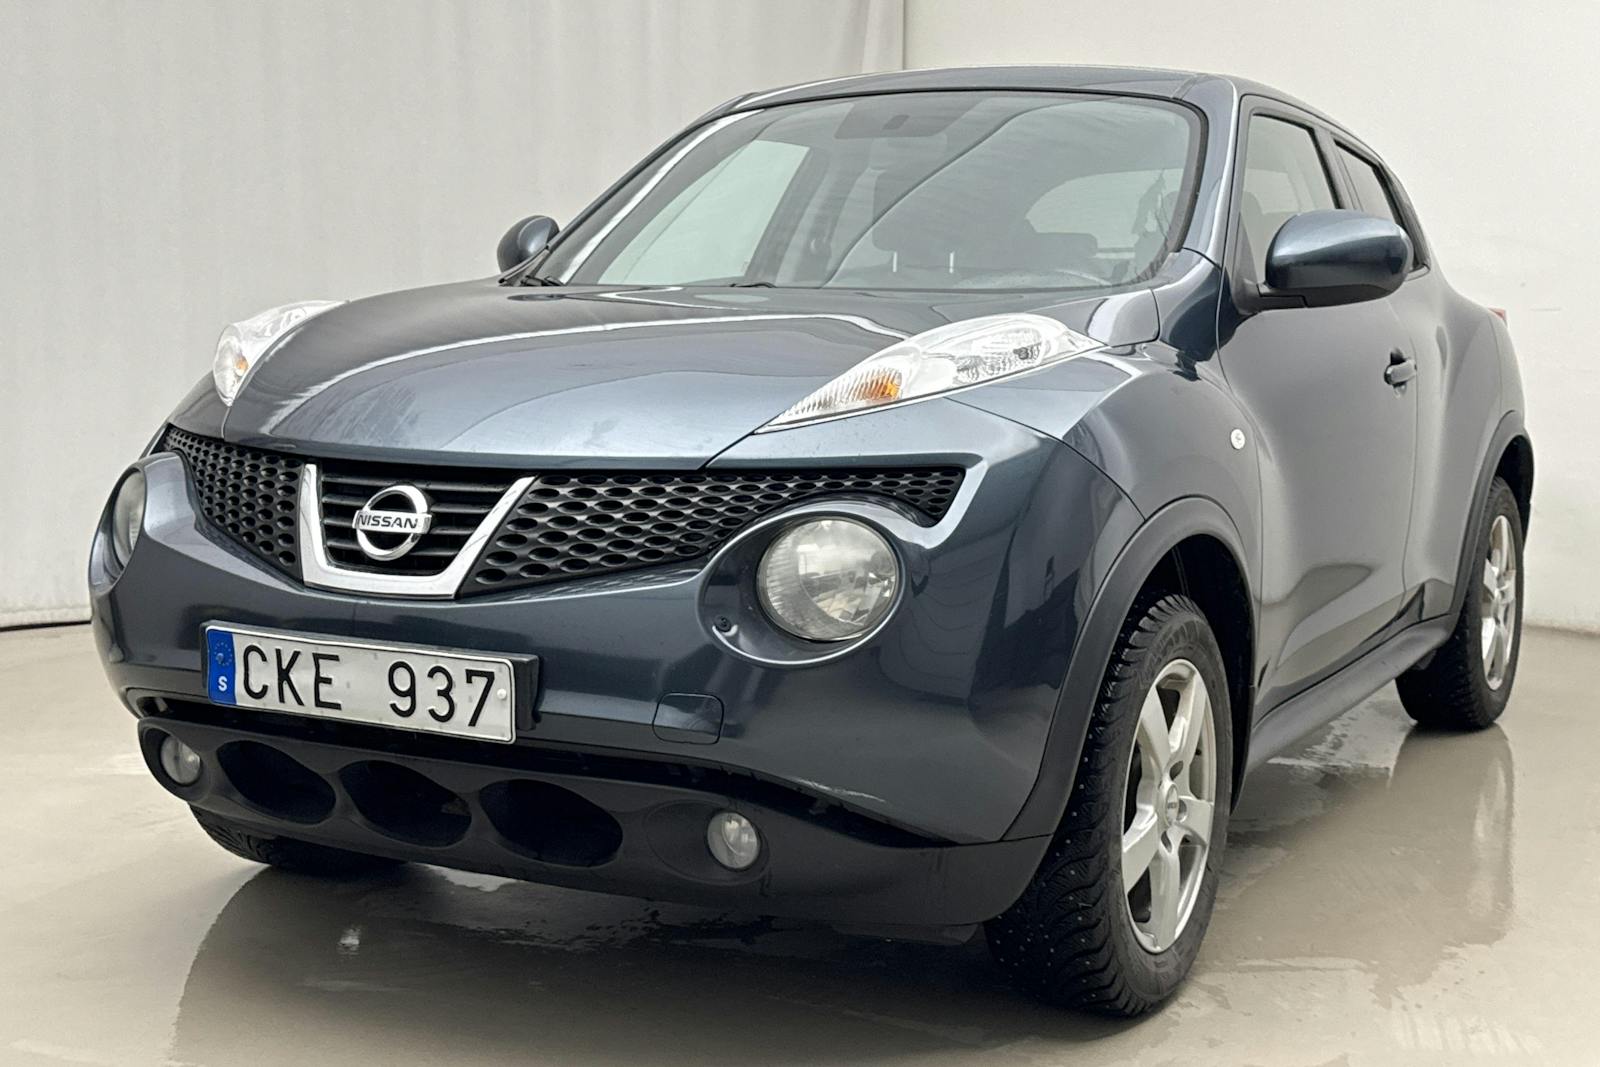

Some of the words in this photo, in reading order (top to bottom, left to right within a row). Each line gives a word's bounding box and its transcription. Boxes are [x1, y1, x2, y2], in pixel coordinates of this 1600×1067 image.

[359, 514, 418, 529] NISSAN
[218, 675, 228, 692] S
[243, 644, 342, 711] CKE
[388, 661, 495, 727] 937
